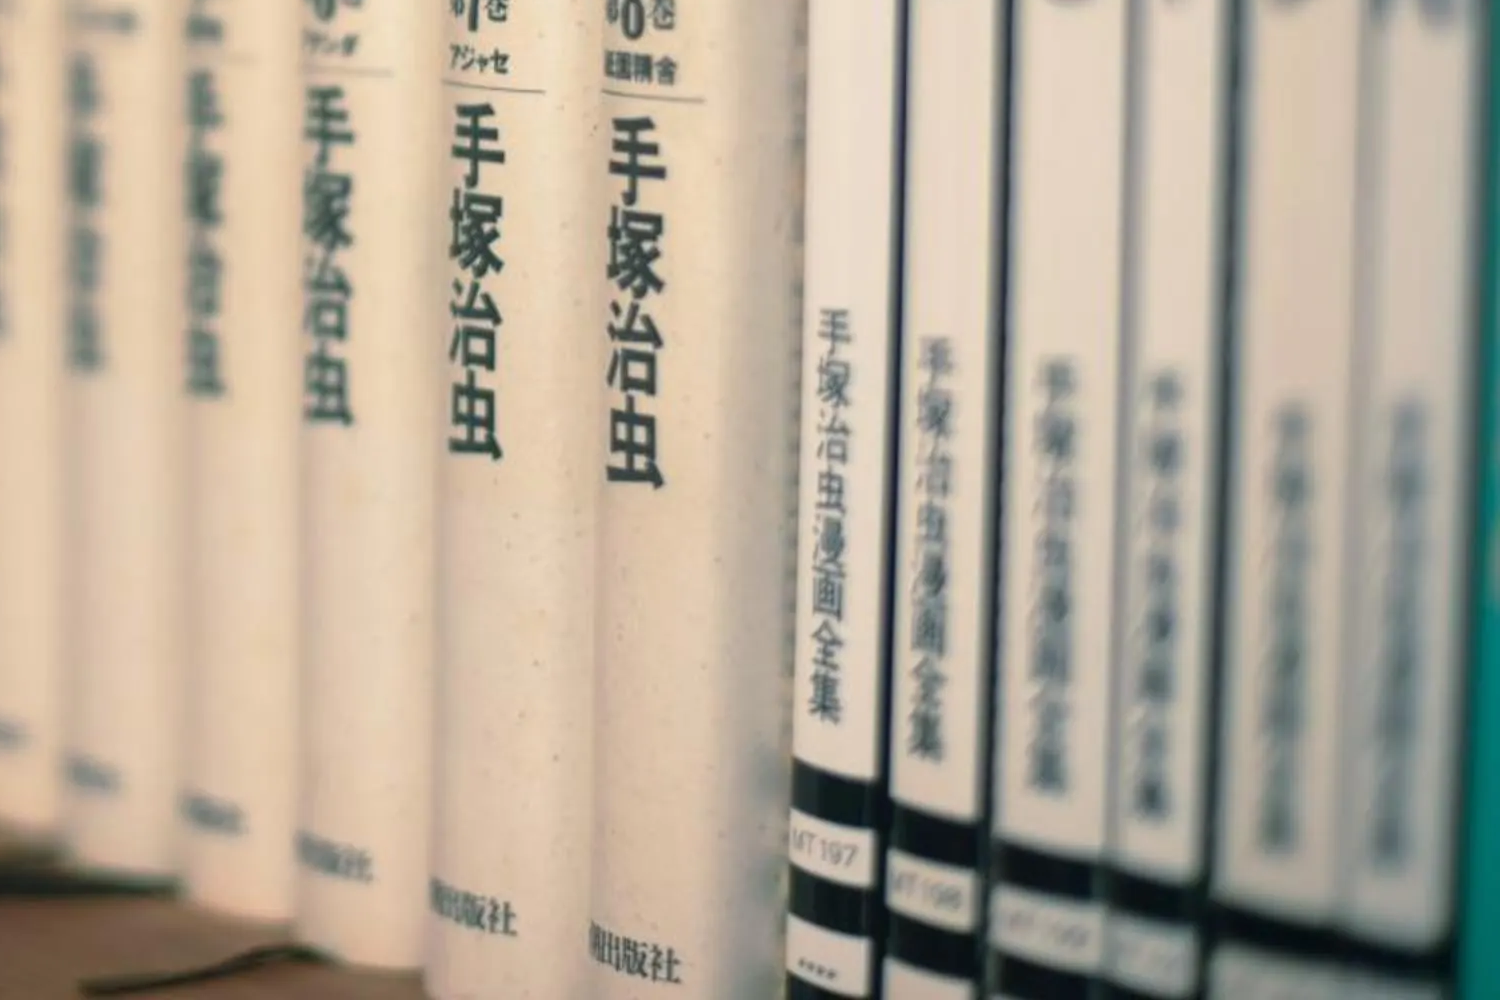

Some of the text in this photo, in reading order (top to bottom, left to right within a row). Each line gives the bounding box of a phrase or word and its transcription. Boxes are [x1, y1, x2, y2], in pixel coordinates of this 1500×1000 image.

[448, 103, 506, 462] 手塚治虫
[606, 116, 667, 491] 手塚治虫
[809, 309, 852, 726] 手塚治虫漫画全集
